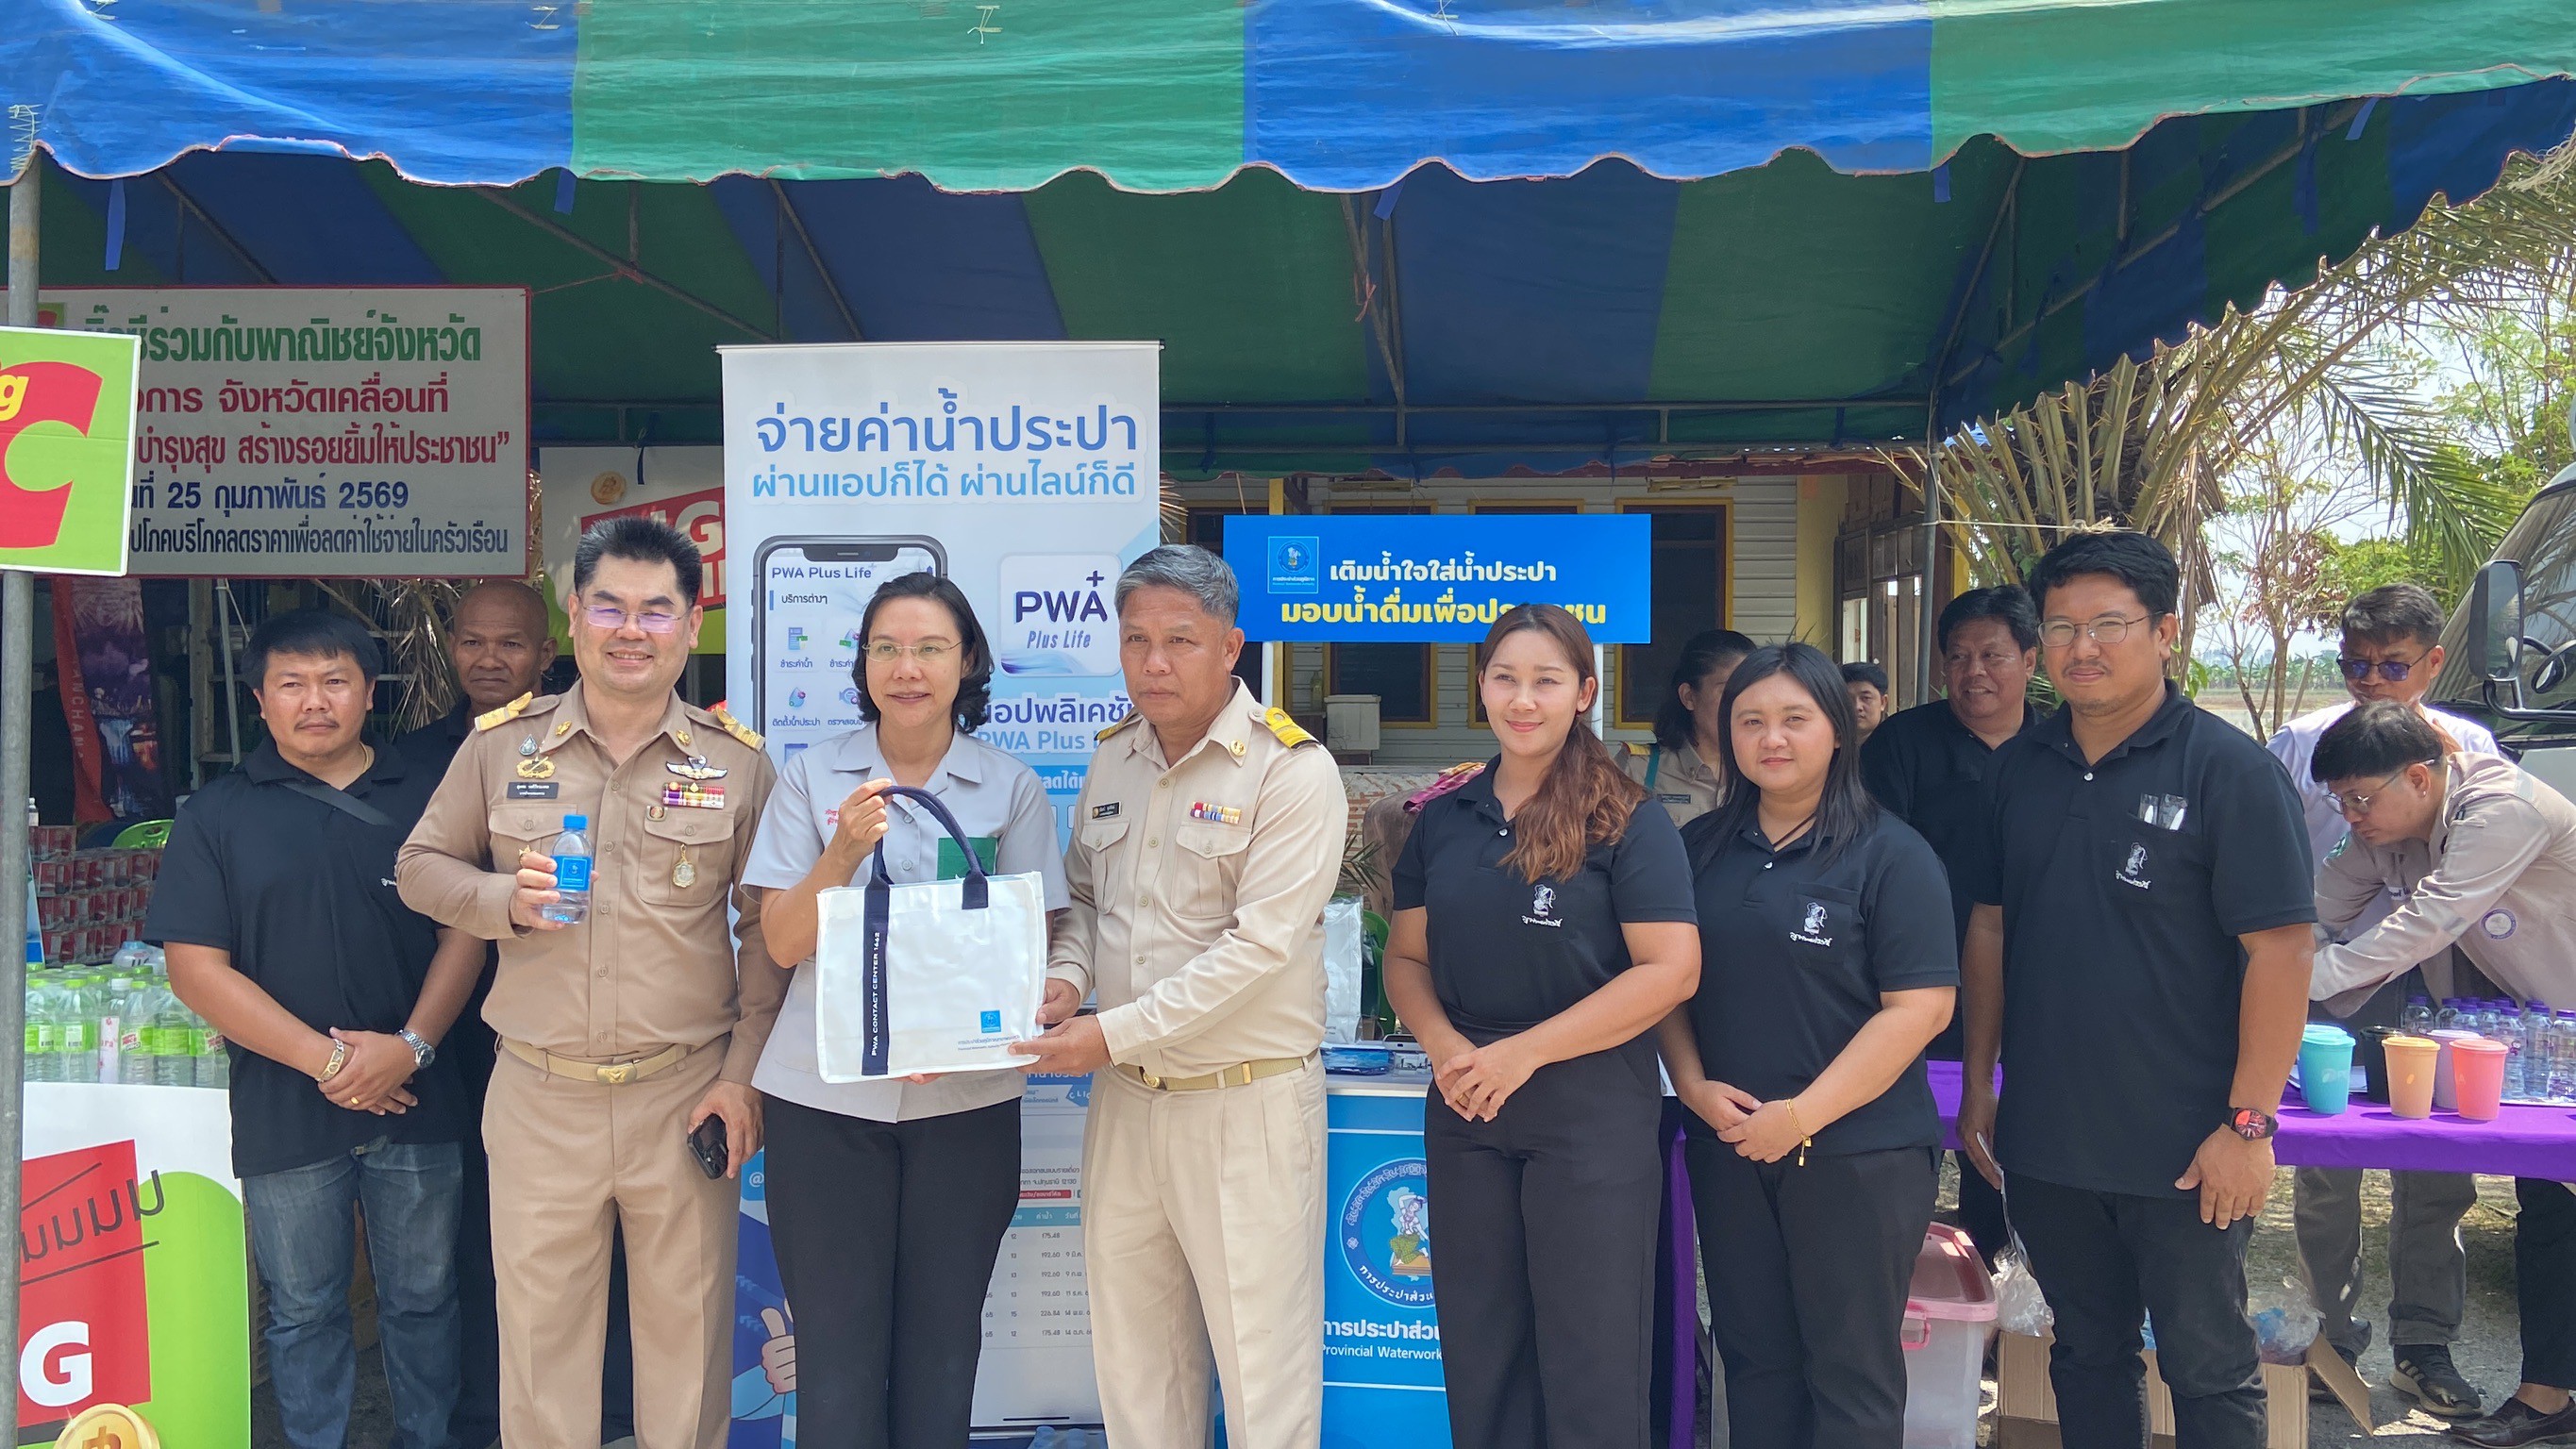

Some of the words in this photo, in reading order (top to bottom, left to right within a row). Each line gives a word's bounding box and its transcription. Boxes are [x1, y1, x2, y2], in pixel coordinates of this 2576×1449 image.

[218, 371, 449, 413] จังหวัดเคลื่อนที่
[756, 388, 1137, 453] จ่ายค่าน้ำประปา
[753, 458, 948, 499] ผ่านแอปก็ได้
[961, 457, 1135, 497] ผ่านไลน์ก็ดี
[167, 481, 202, 509] 25
[214, 472, 326, 518] กุมภาพันธ์
[339, 481, 410, 509] 2569
[772, 567, 804, 578] PWA
[809, 567, 841, 578] Plus
[845, 567, 872, 578] Life
[1330, 550, 1557, 582] เติมน้ำใจใส่น้ำประปา
[781, 592, 828, 605] บริการต่างๆ
[1014, 591, 1108, 624] PWA
[1280, 587, 1607, 625] มอบน้ำดื่มเพื่อปชน
[1027, 630, 1059, 649] Plus
[1063, 630, 1091, 649] Life
[1038, 729, 1085, 750] Plus
